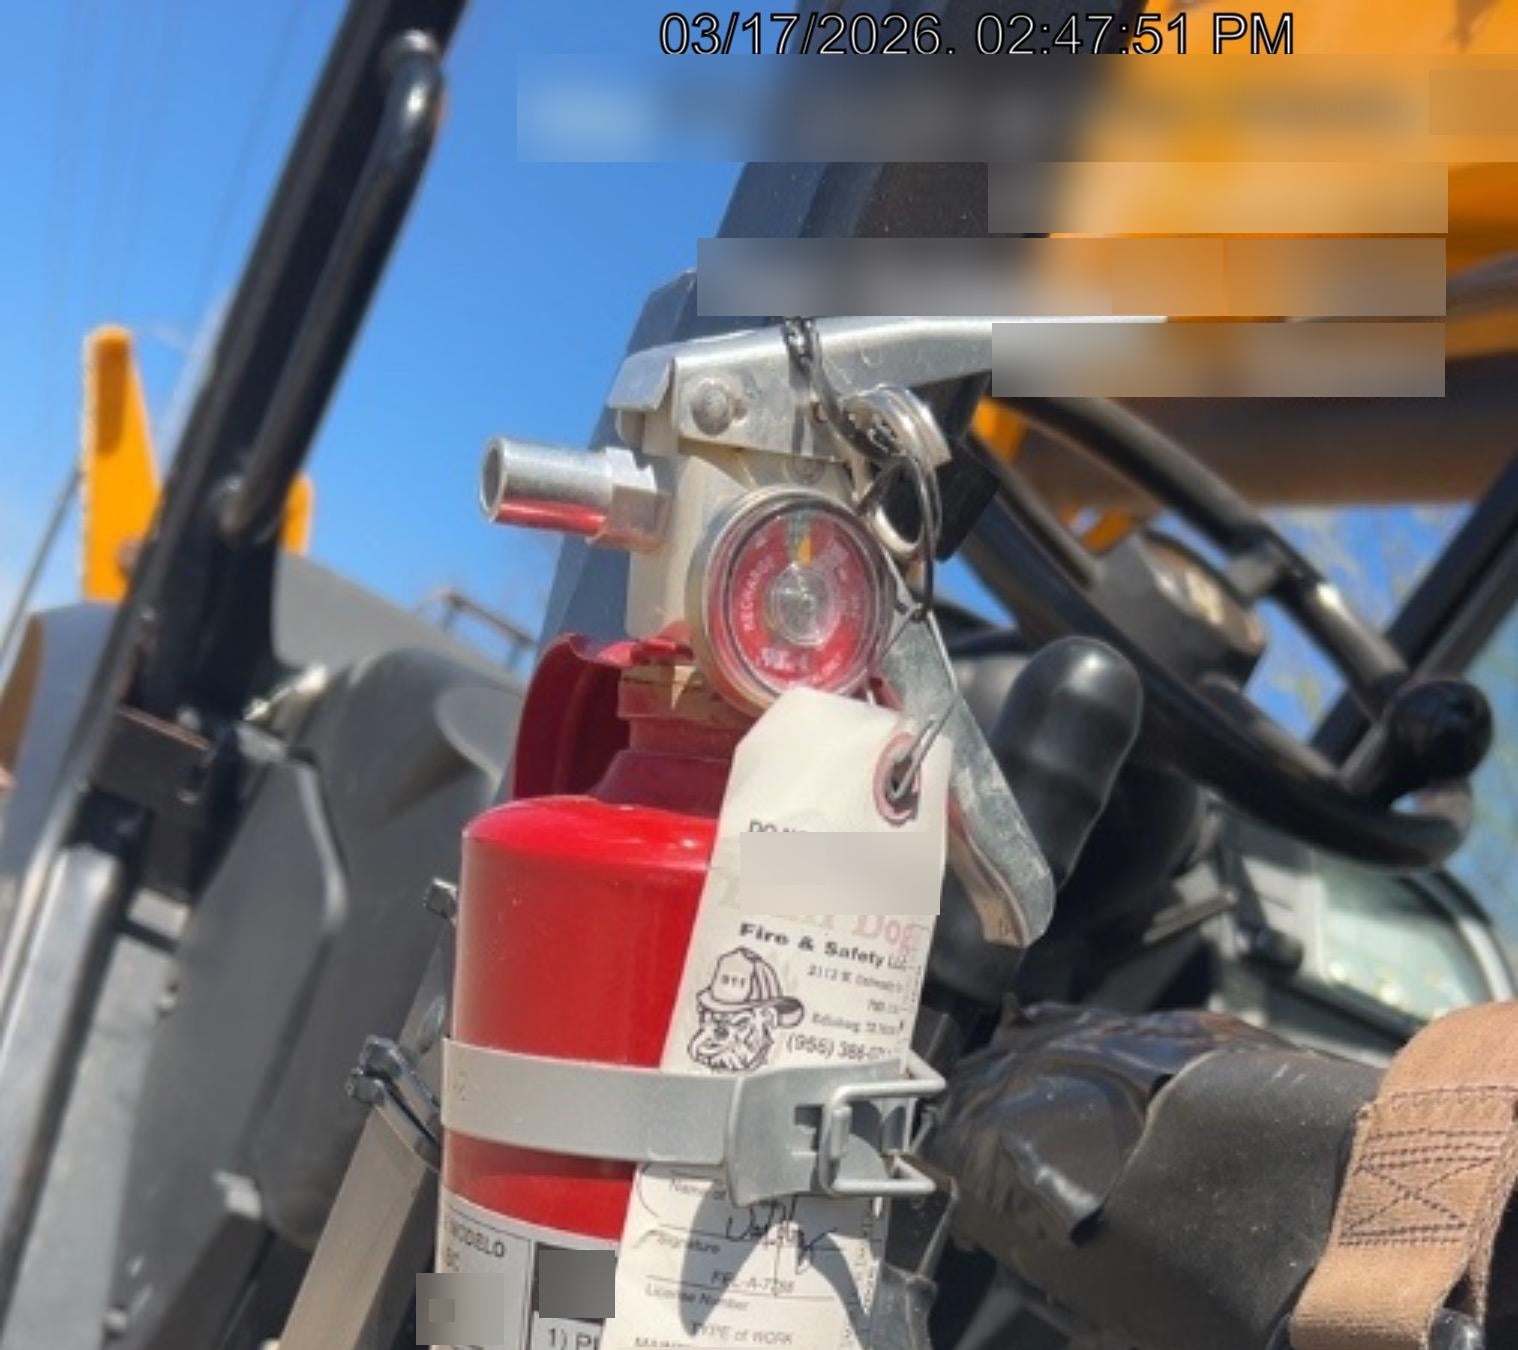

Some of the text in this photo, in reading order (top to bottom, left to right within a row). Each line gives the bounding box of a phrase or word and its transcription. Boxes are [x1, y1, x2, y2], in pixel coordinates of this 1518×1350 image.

[739, 922, 789, 946] Fire
[797, 935, 815, 951] &
[824, 941, 885, 969] Safety
